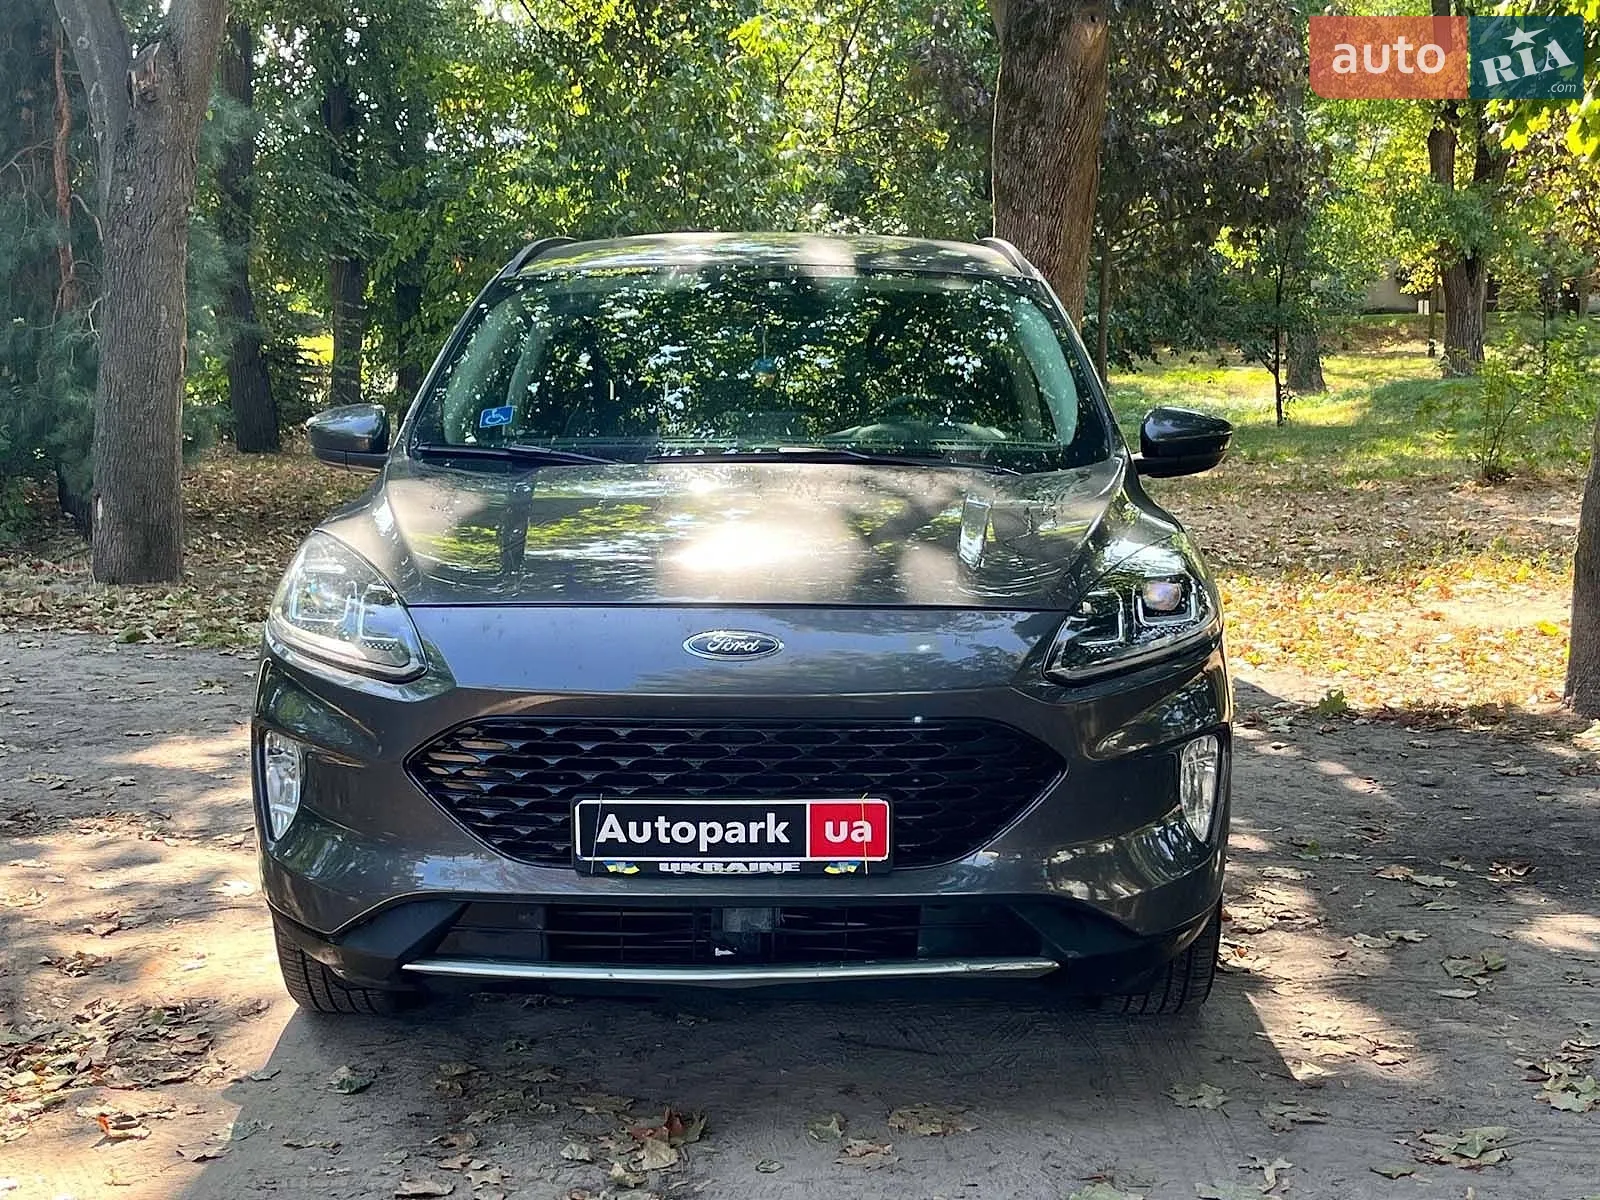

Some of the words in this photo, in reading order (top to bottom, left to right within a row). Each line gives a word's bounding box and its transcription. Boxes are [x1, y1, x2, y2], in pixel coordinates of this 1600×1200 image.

[707, 633, 760, 652] Ford
[597, 812, 790, 852] Autopark
[824, 819, 873, 843] ua
[658, 861, 801, 874] UKRAINE
